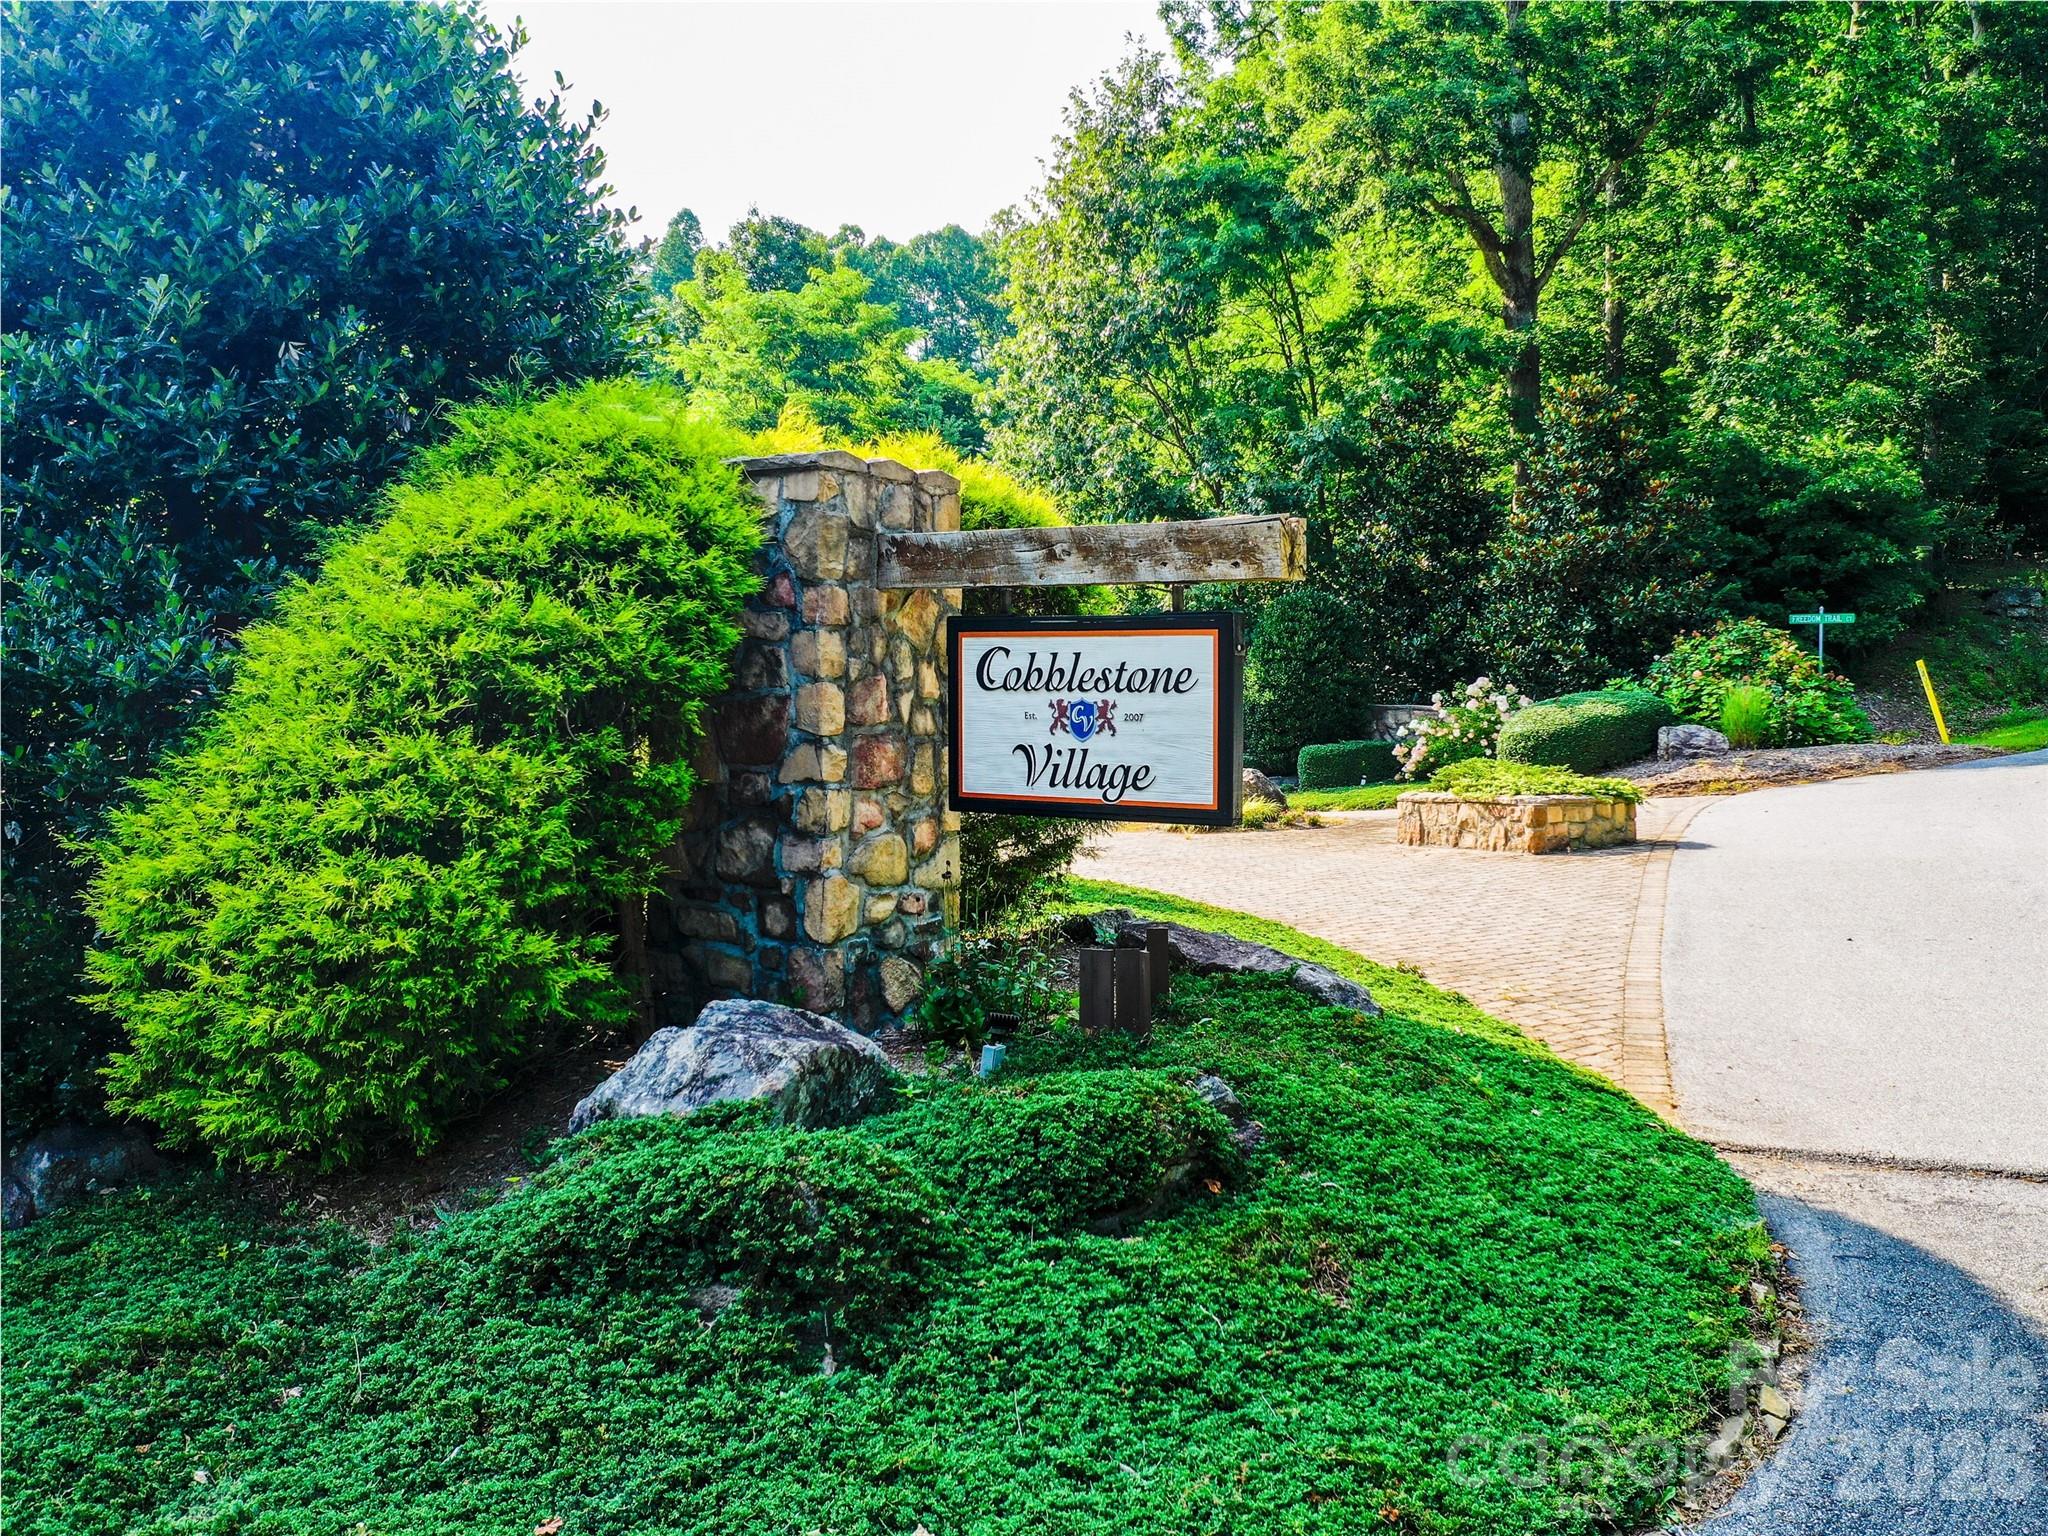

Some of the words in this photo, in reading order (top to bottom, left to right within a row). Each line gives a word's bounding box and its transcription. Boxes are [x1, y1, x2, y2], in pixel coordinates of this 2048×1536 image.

[1791, 615, 1821, 623] FREEDOM
[976, 646, 1199, 694] Cobblestone
[1024, 711, 1038, 720] Est.
[1124, 713, 1144, 722] 2007
[1012, 743, 1156, 803] Village
